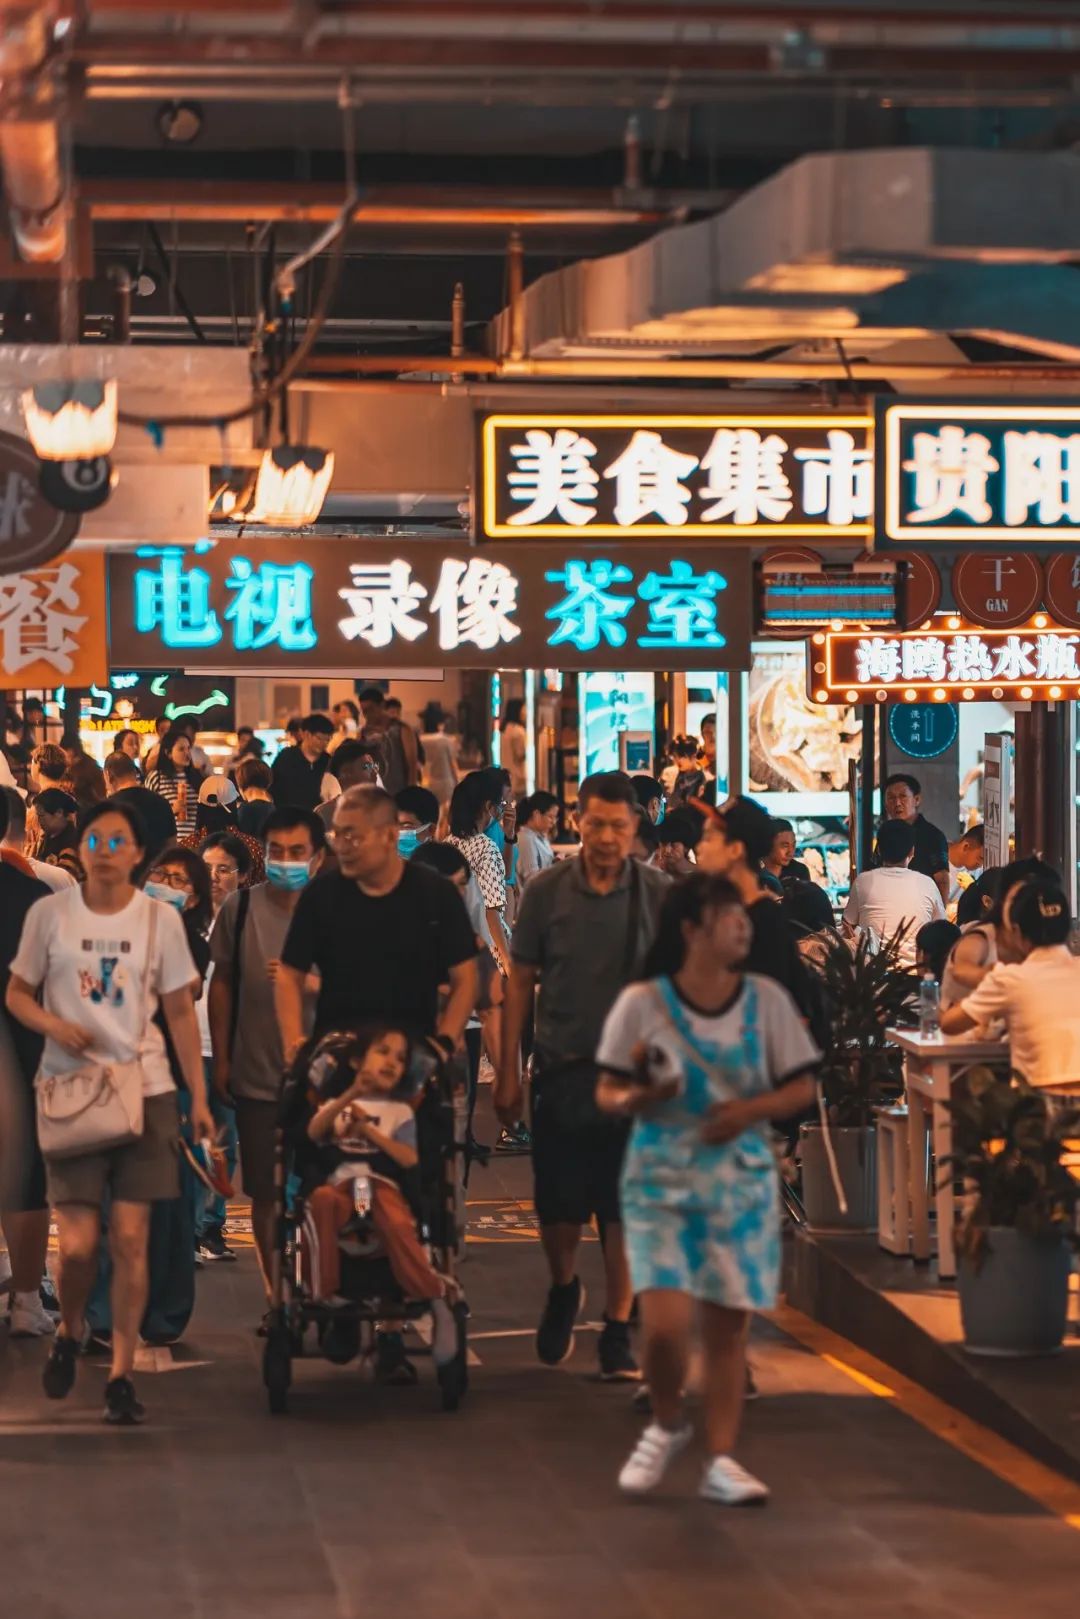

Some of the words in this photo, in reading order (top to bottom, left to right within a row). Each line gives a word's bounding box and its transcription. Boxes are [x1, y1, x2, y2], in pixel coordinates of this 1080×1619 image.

[506, 428, 873, 526] 美食集市
[902, 425, 1080, 526] 贵阳
[0, 562, 90, 676] 餐
[135, 540, 319, 650] 电视
[337, 557, 522, 650] 录像
[544, 559, 728, 650] 茶室
[985, 598, 1009, 613] GAN
[856, 633, 1080, 683] 海鸥热水瓶
[910, 709, 921, 743] 洗手间
